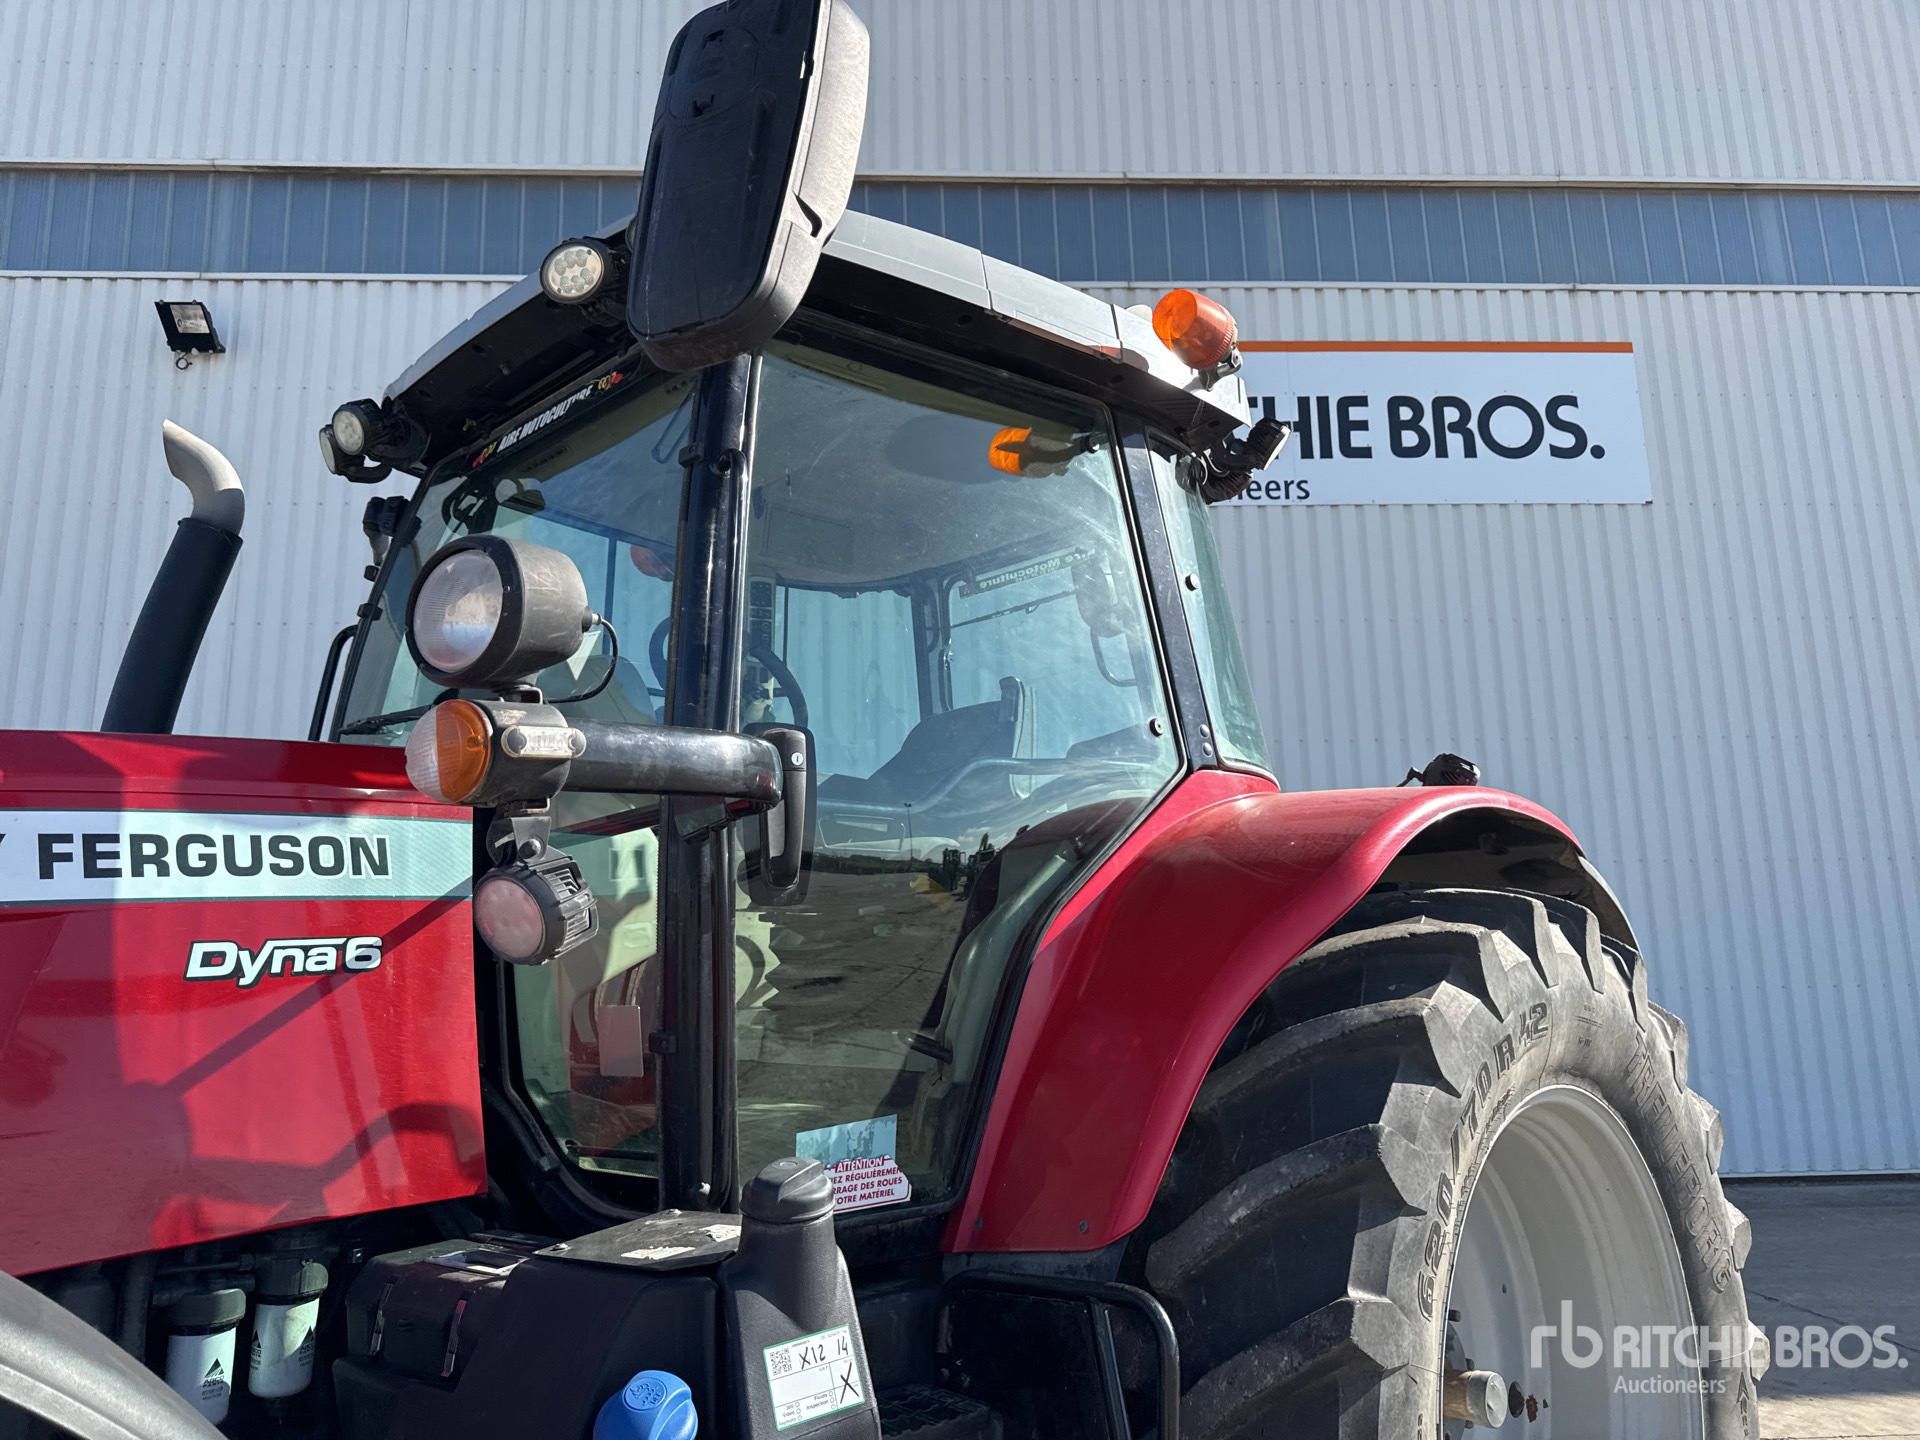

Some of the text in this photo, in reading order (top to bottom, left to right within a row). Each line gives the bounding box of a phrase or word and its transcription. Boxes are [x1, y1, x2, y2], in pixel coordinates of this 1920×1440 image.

[1247, 395, 1606, 460] HIE BROS.
[1237, 479, 1310, 500] eers
[37, 833, 391, 880] FERGUSON
[836, 1156, 884, 1173] ATTENTION
[860, 1180, 875, 1191] DES
[877, 1176, 903, 1189] ROUES
[834, 1187, 894, 1205] OTRE MATÉRIEL
[837, 1335, 849, 1356] 14
[782, 1410, 796, 1418] Video
